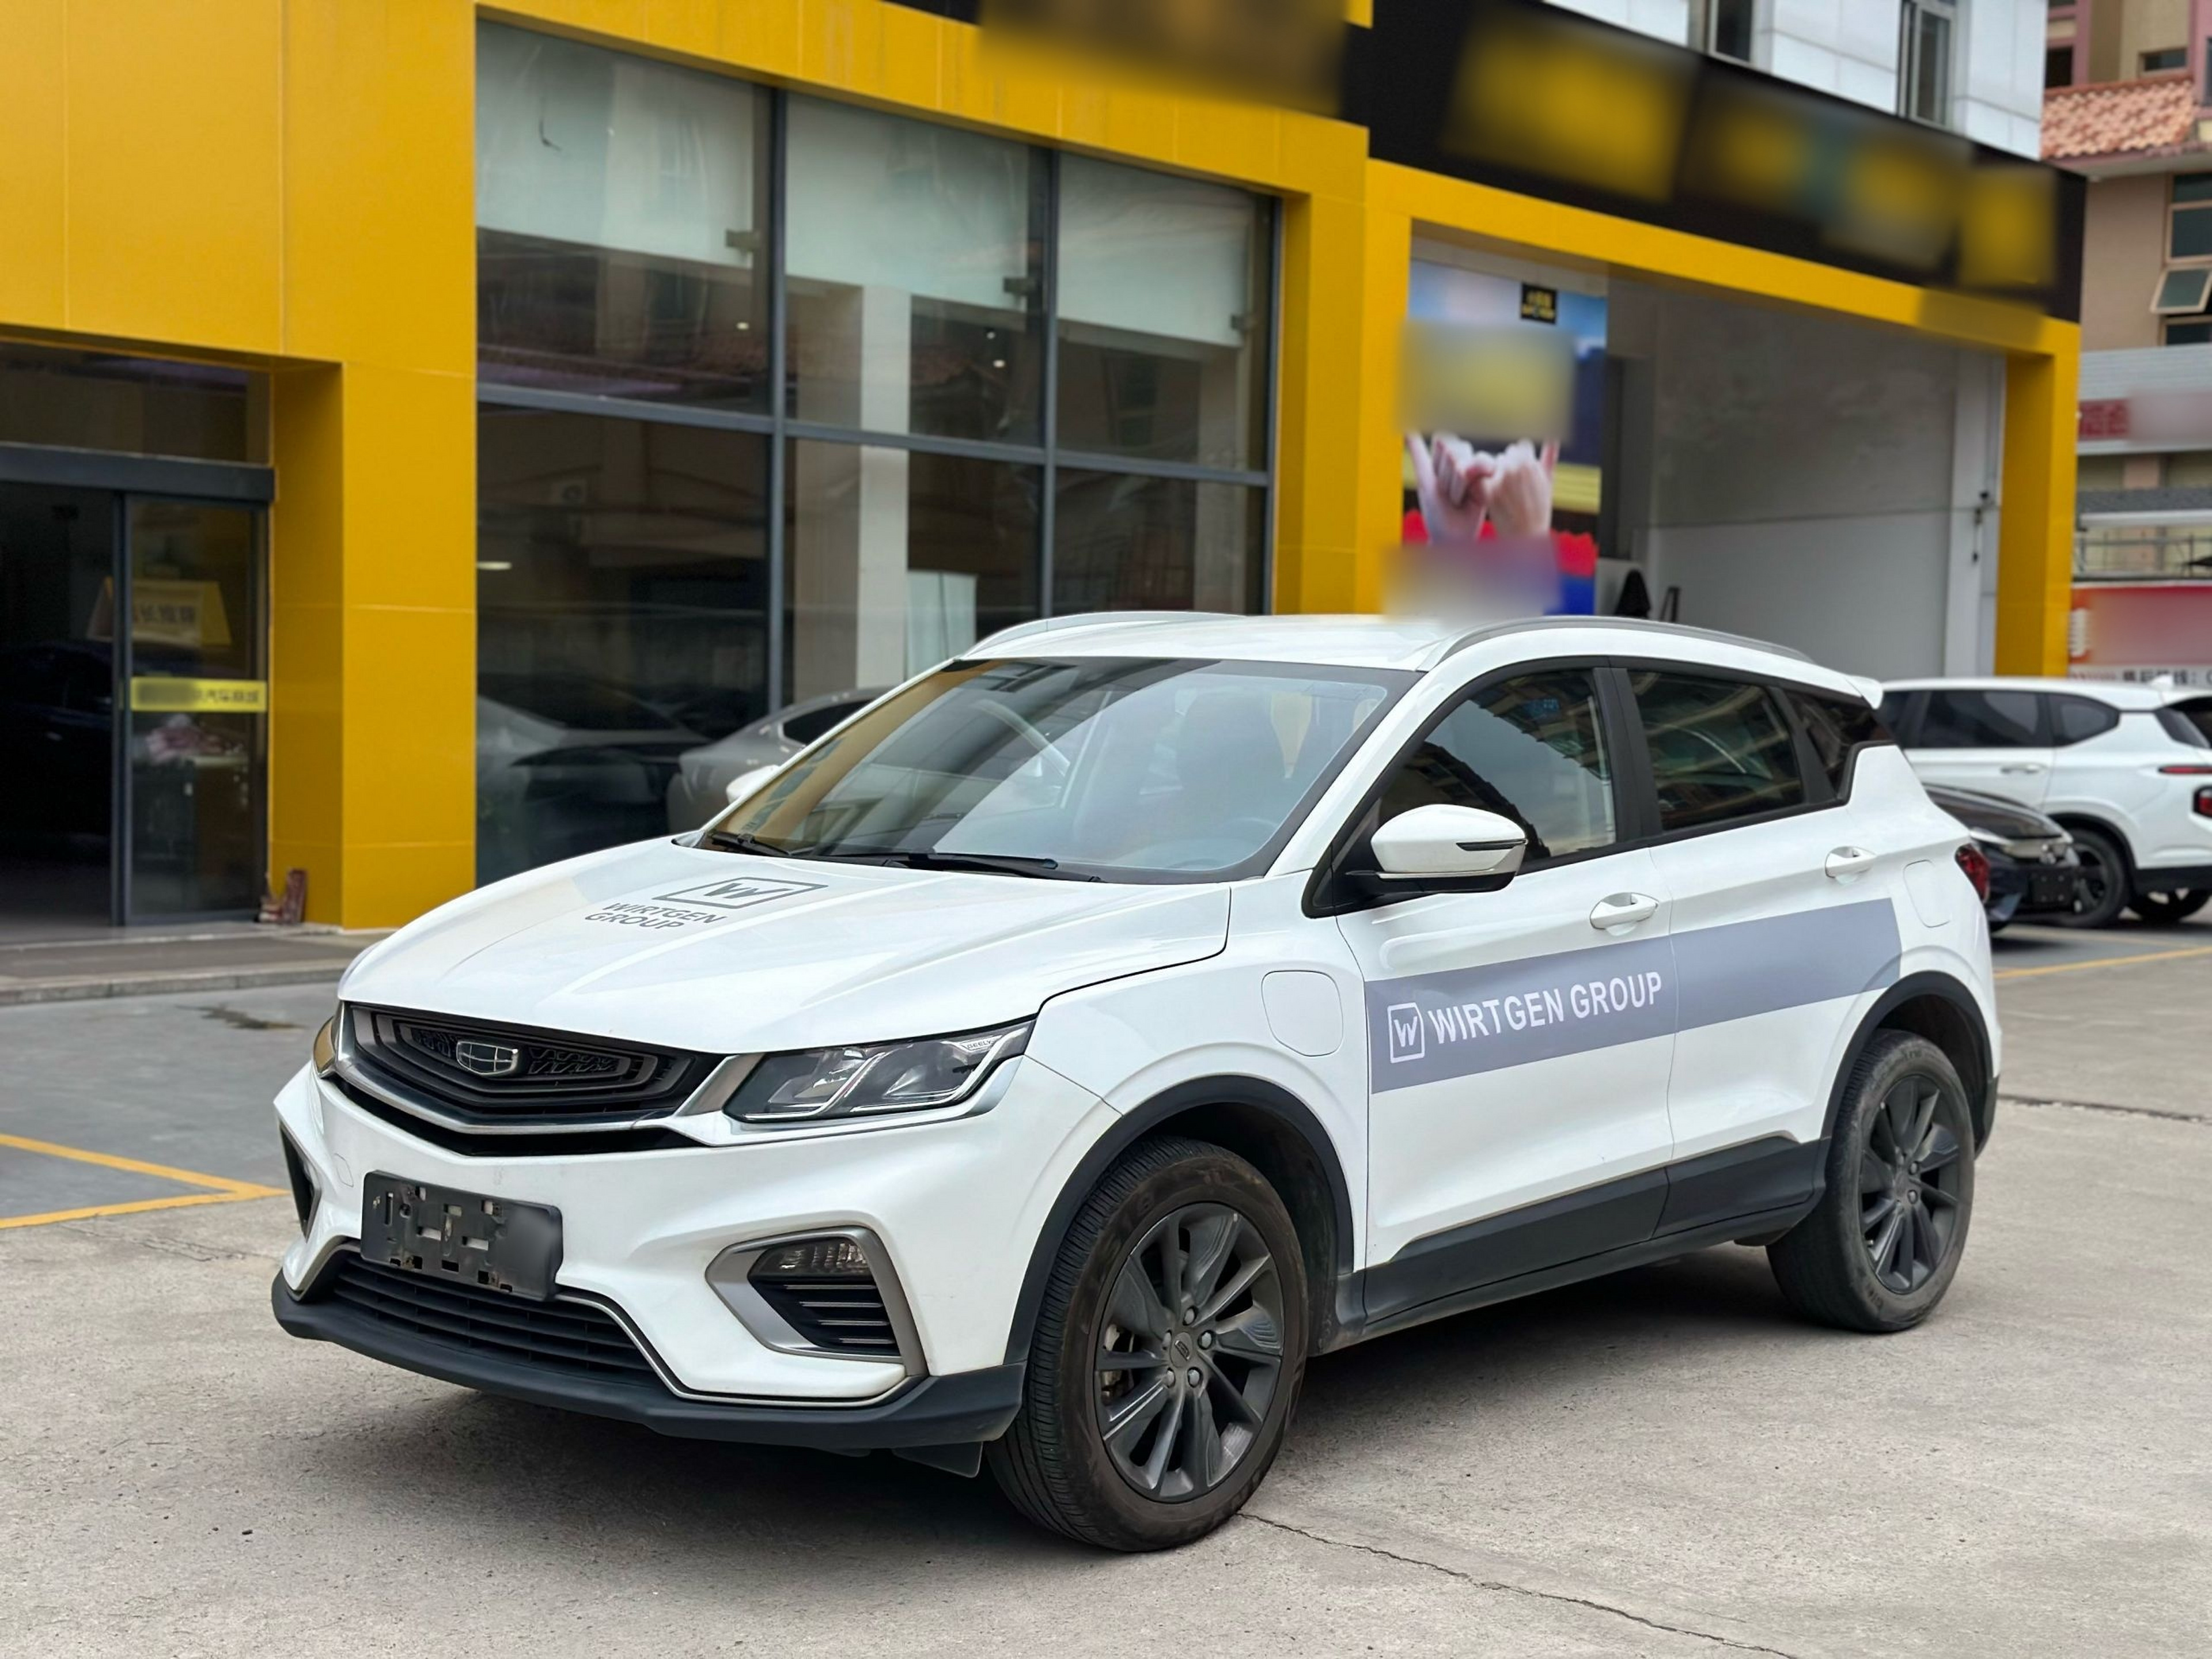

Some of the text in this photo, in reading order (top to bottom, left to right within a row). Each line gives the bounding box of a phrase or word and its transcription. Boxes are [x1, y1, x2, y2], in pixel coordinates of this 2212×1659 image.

[585, 912, 685, 929] GROUP
[602, 902, 728, 923] WIRTGEN
[1393, 971, 1662, 1047] W WIRTGEN GROUP
[967, 1040, 991, 1048] GEELY
